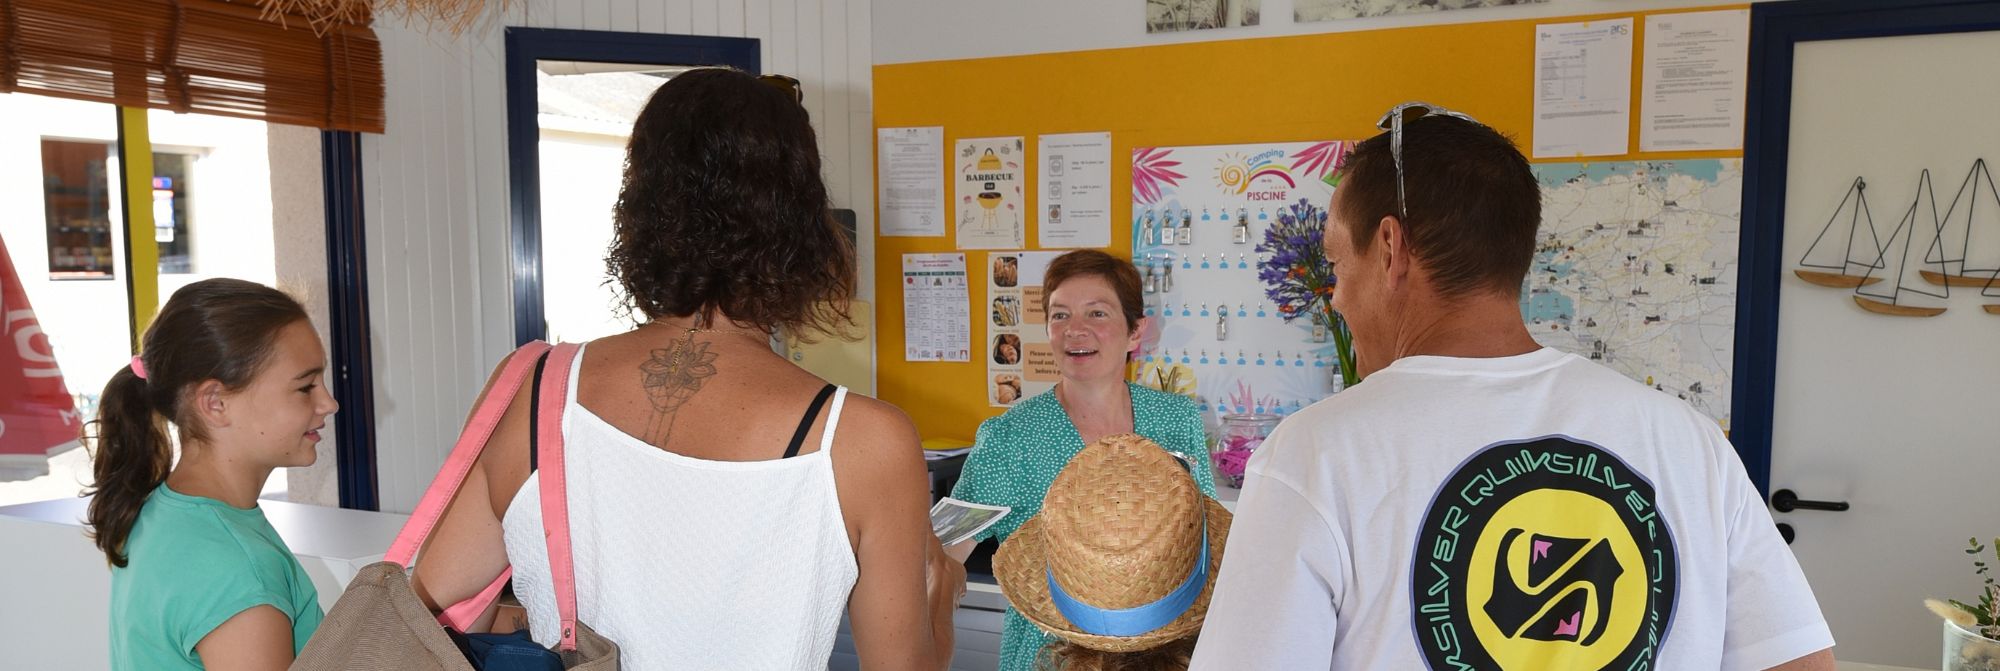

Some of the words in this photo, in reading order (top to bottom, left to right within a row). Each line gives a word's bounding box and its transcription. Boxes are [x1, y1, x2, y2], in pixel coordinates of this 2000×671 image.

[1247, 149, 1285, 166] Camping
[965, 172, 1014, 182] BARBECUE
[1247, 191, 1286, 201] PISCINE
